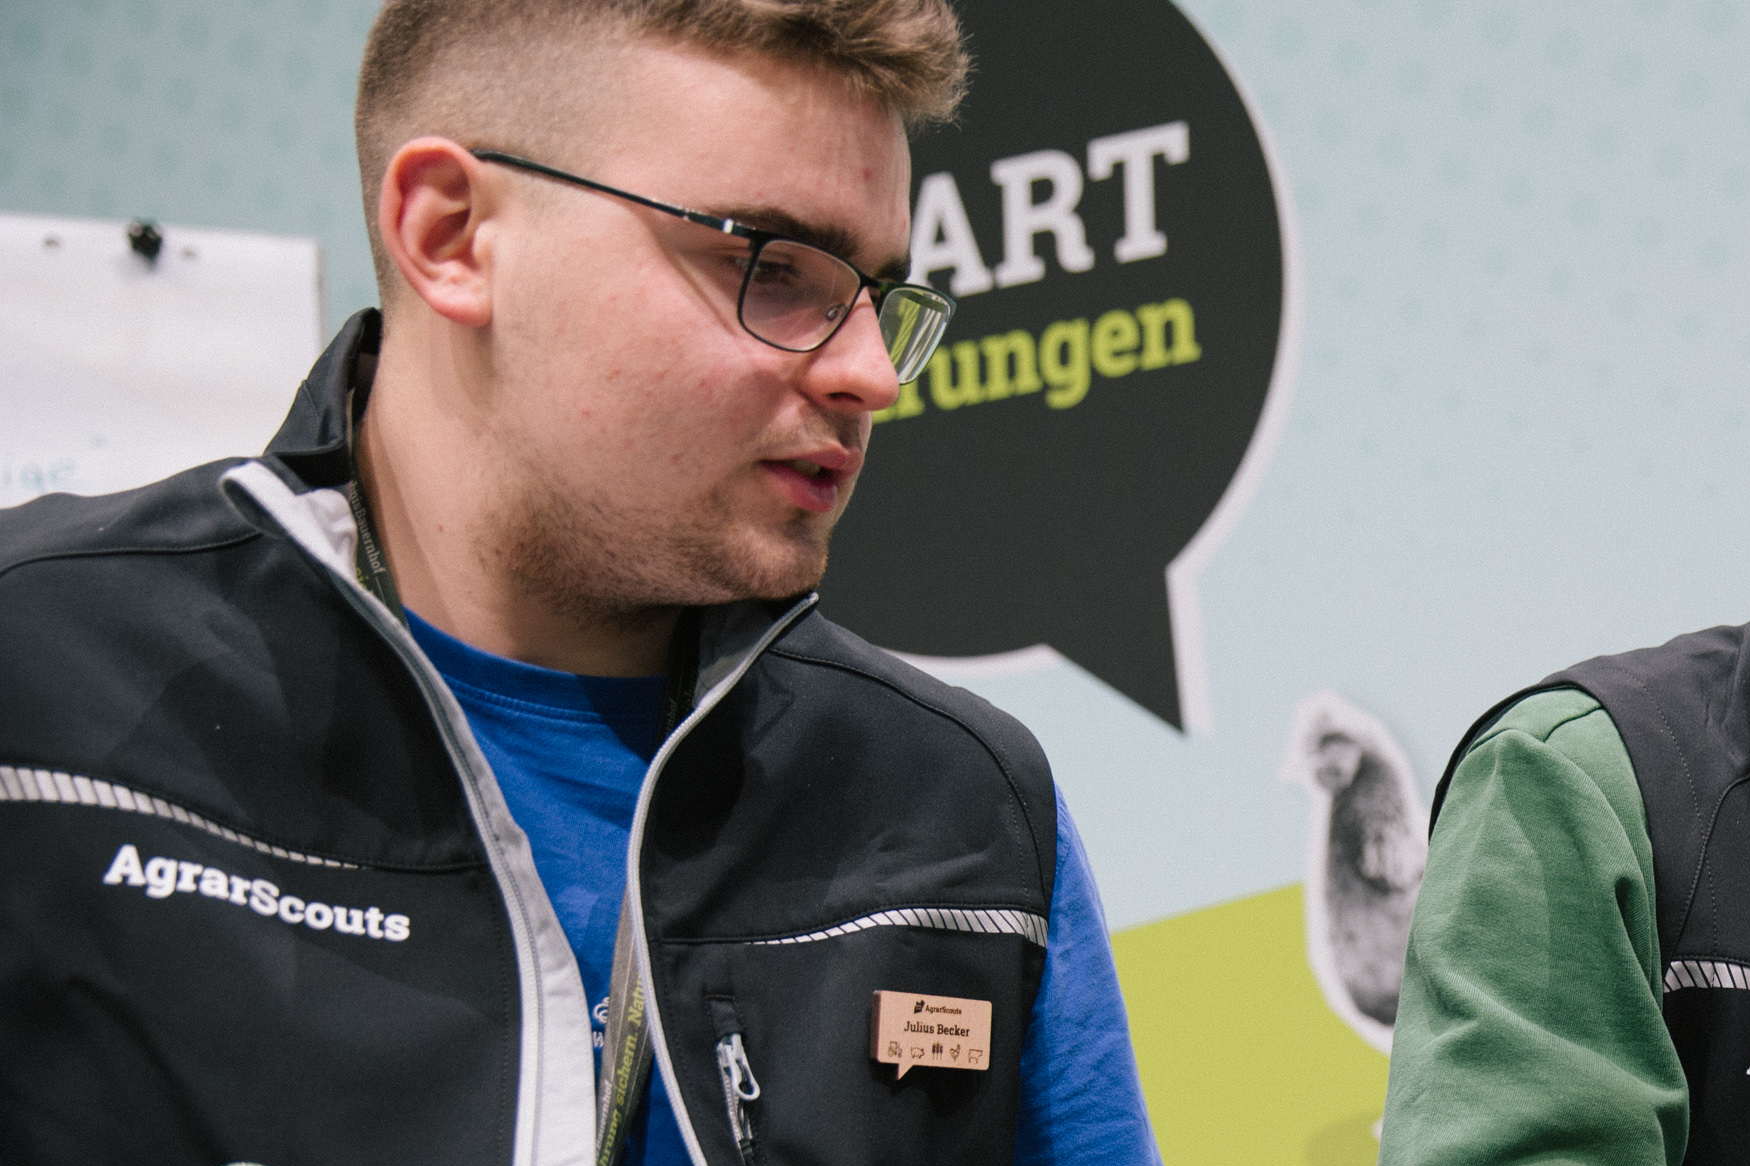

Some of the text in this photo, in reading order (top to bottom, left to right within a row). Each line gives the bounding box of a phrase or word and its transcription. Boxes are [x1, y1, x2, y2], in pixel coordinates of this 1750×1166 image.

[102, 842, 411, 942] AgrarScouts
[903, 1020, 971, 1037] Julius Becker
